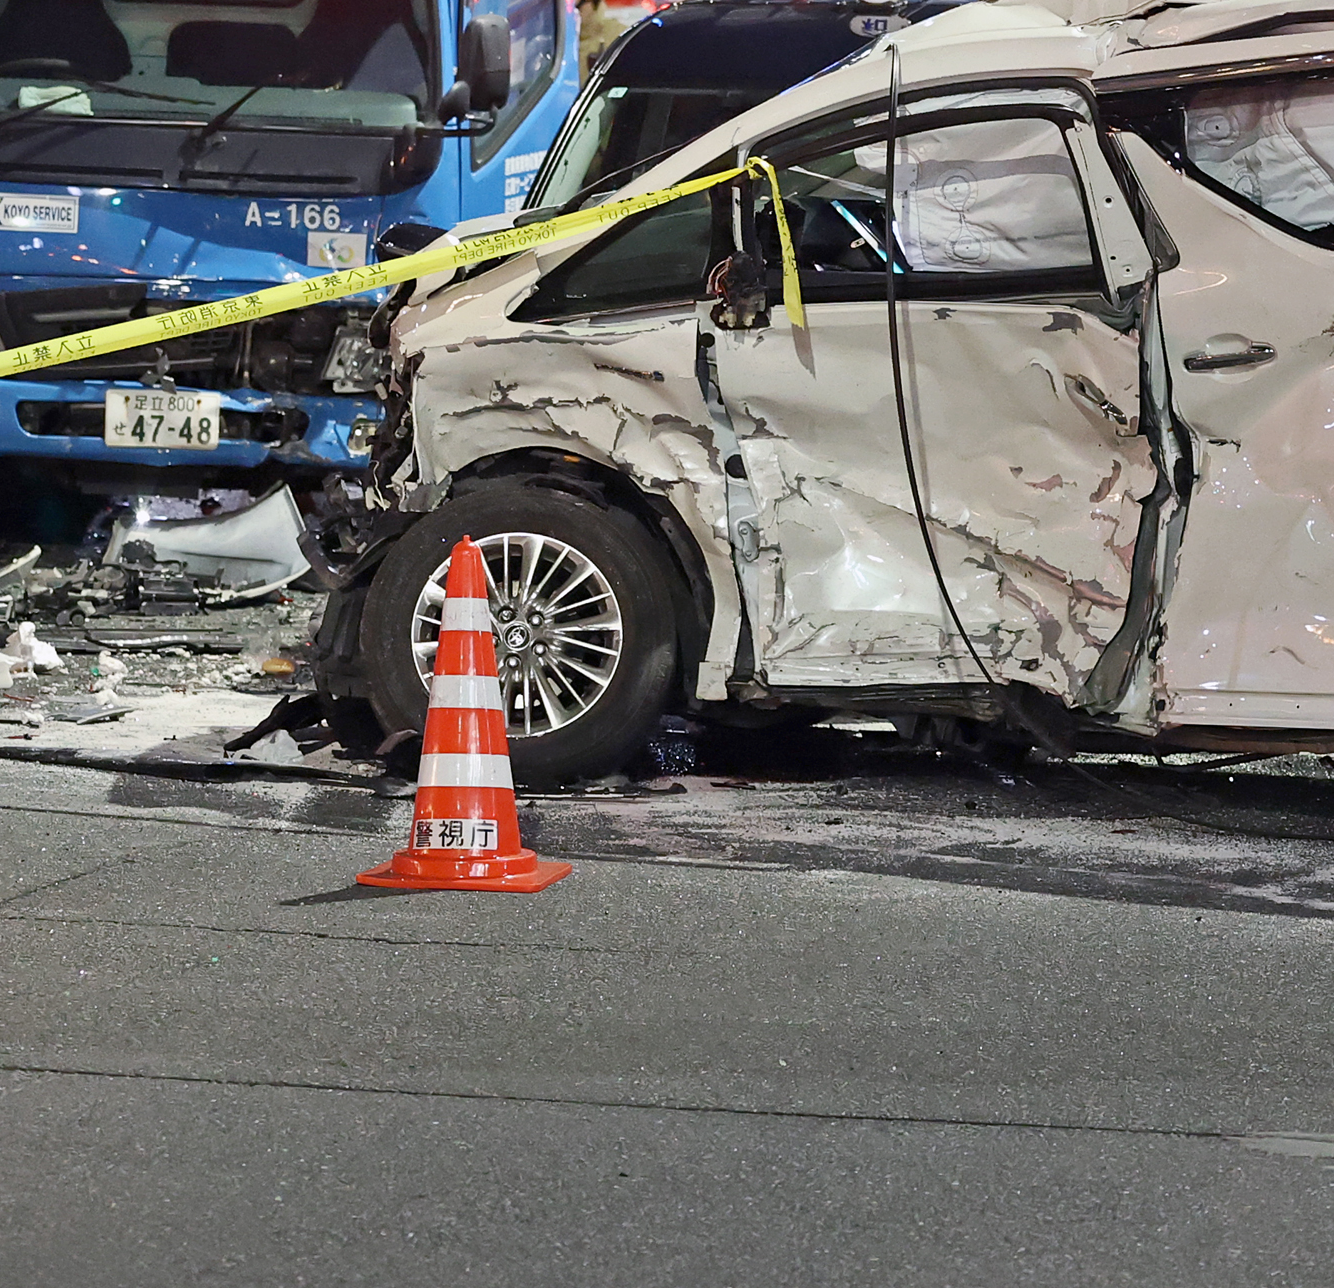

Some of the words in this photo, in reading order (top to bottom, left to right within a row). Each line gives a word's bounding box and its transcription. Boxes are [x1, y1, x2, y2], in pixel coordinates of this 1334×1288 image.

[3, 204, 31, 219] KOYO
[33, 205, 72, 222] SERVICE
[113, 421, 127, 436] せ
[131, 415, 211, 445] 47-48
[416, 820, 495, 847] 警視庁
